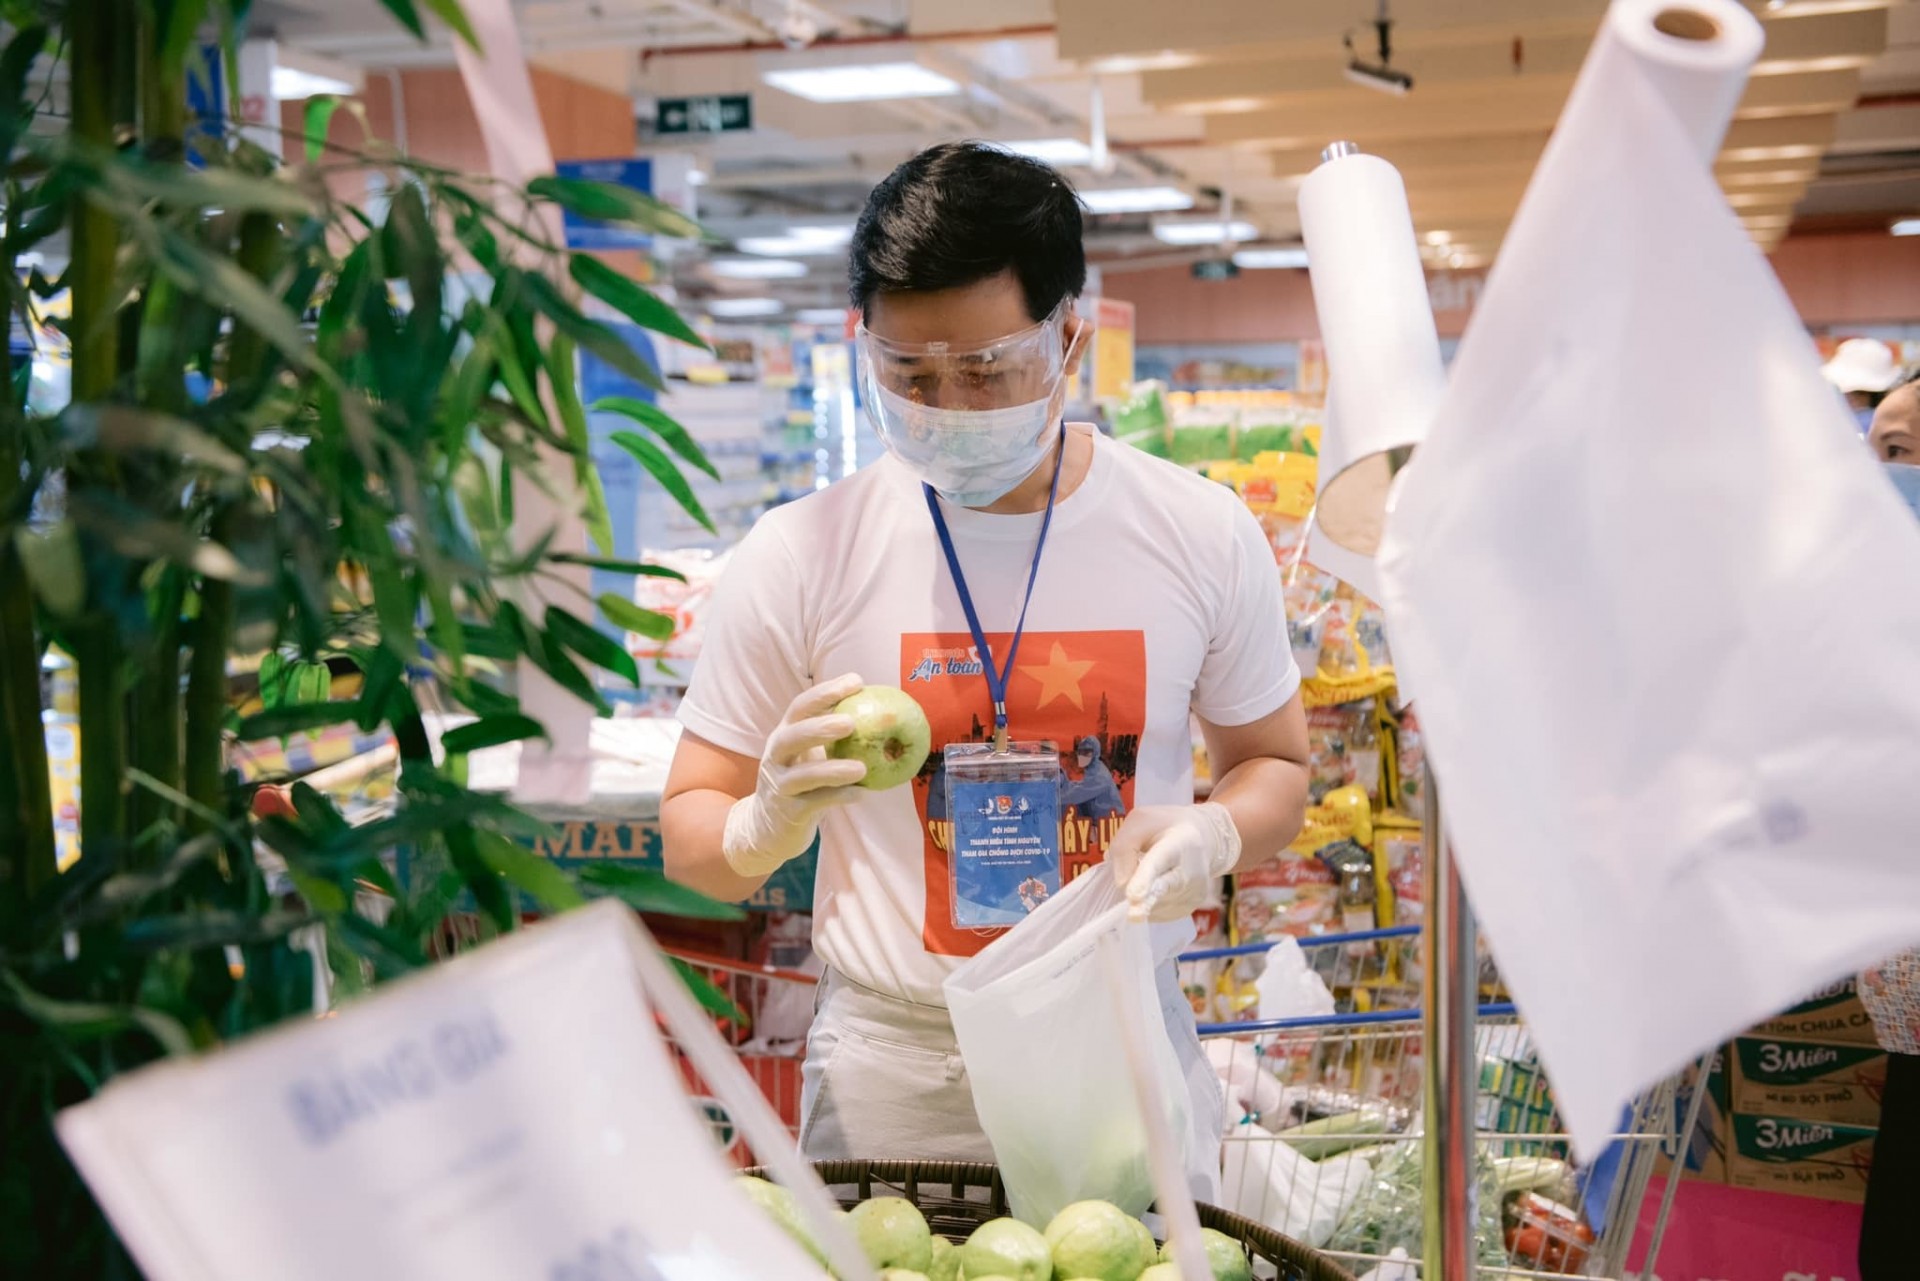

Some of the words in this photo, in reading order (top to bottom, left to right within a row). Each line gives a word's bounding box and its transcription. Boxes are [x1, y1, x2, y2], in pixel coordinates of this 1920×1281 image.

[908, 657, 941, 682] An
[534, 821, 662, 858] MAF
[1058, 806, 1091, 853] ẨY
[1099, 811, 1125, 851] LÙ
[1024, 848, 1051, 856] COVID-19
[1800, 1018, 1846, 1034] CHUA
[1848, 1012, 1874, 1027] CA
